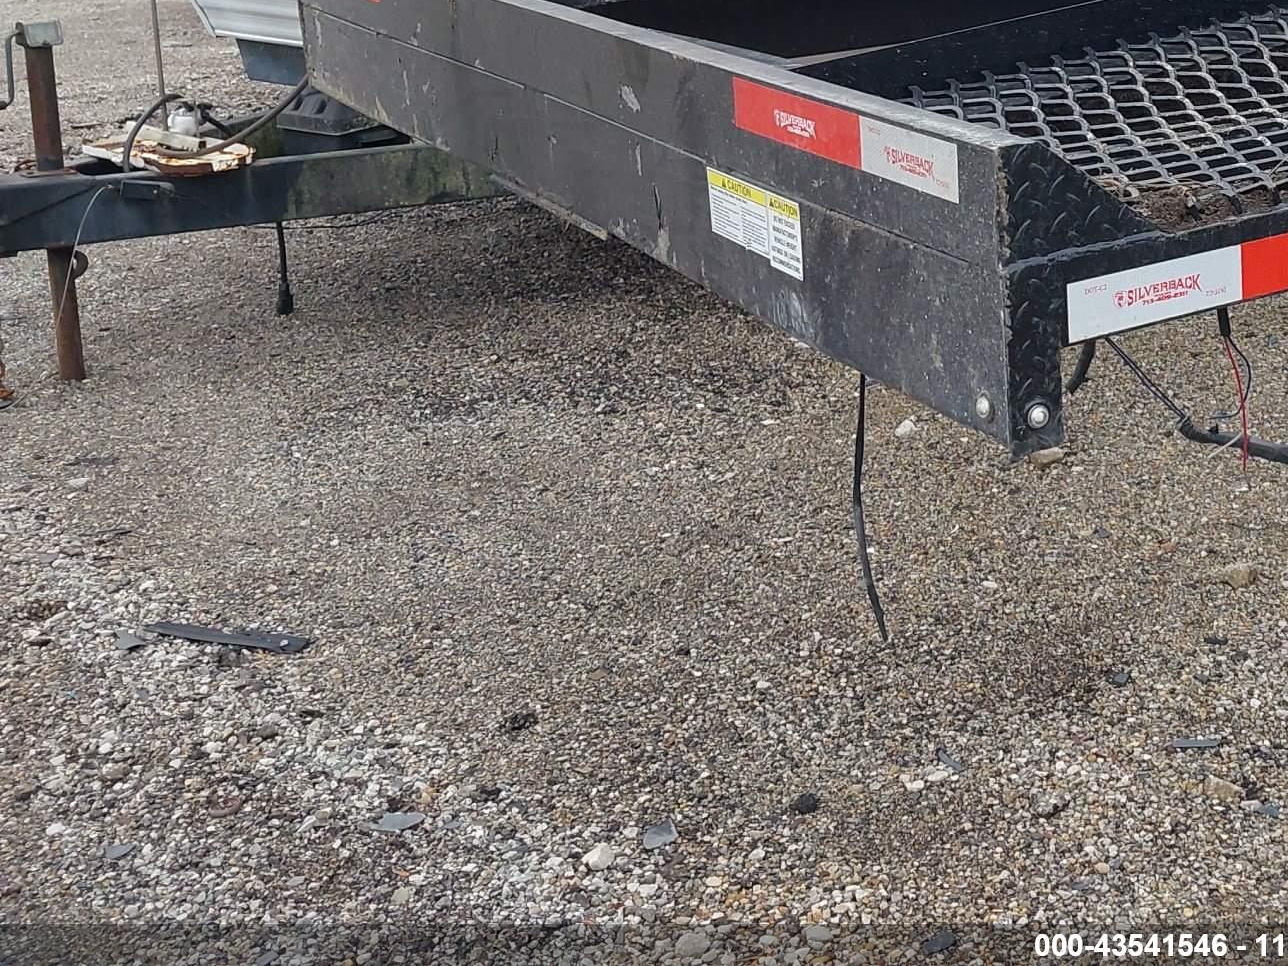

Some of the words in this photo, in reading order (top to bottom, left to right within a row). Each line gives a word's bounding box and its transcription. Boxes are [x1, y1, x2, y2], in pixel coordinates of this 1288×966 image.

[891, 148, 935, 181] SILVERBACK
[727, 179, 752, 199] CAUTION
[773, 199, 798, 217] CAUTION
[1127, 273, 1202, 307] SILVERBACK
